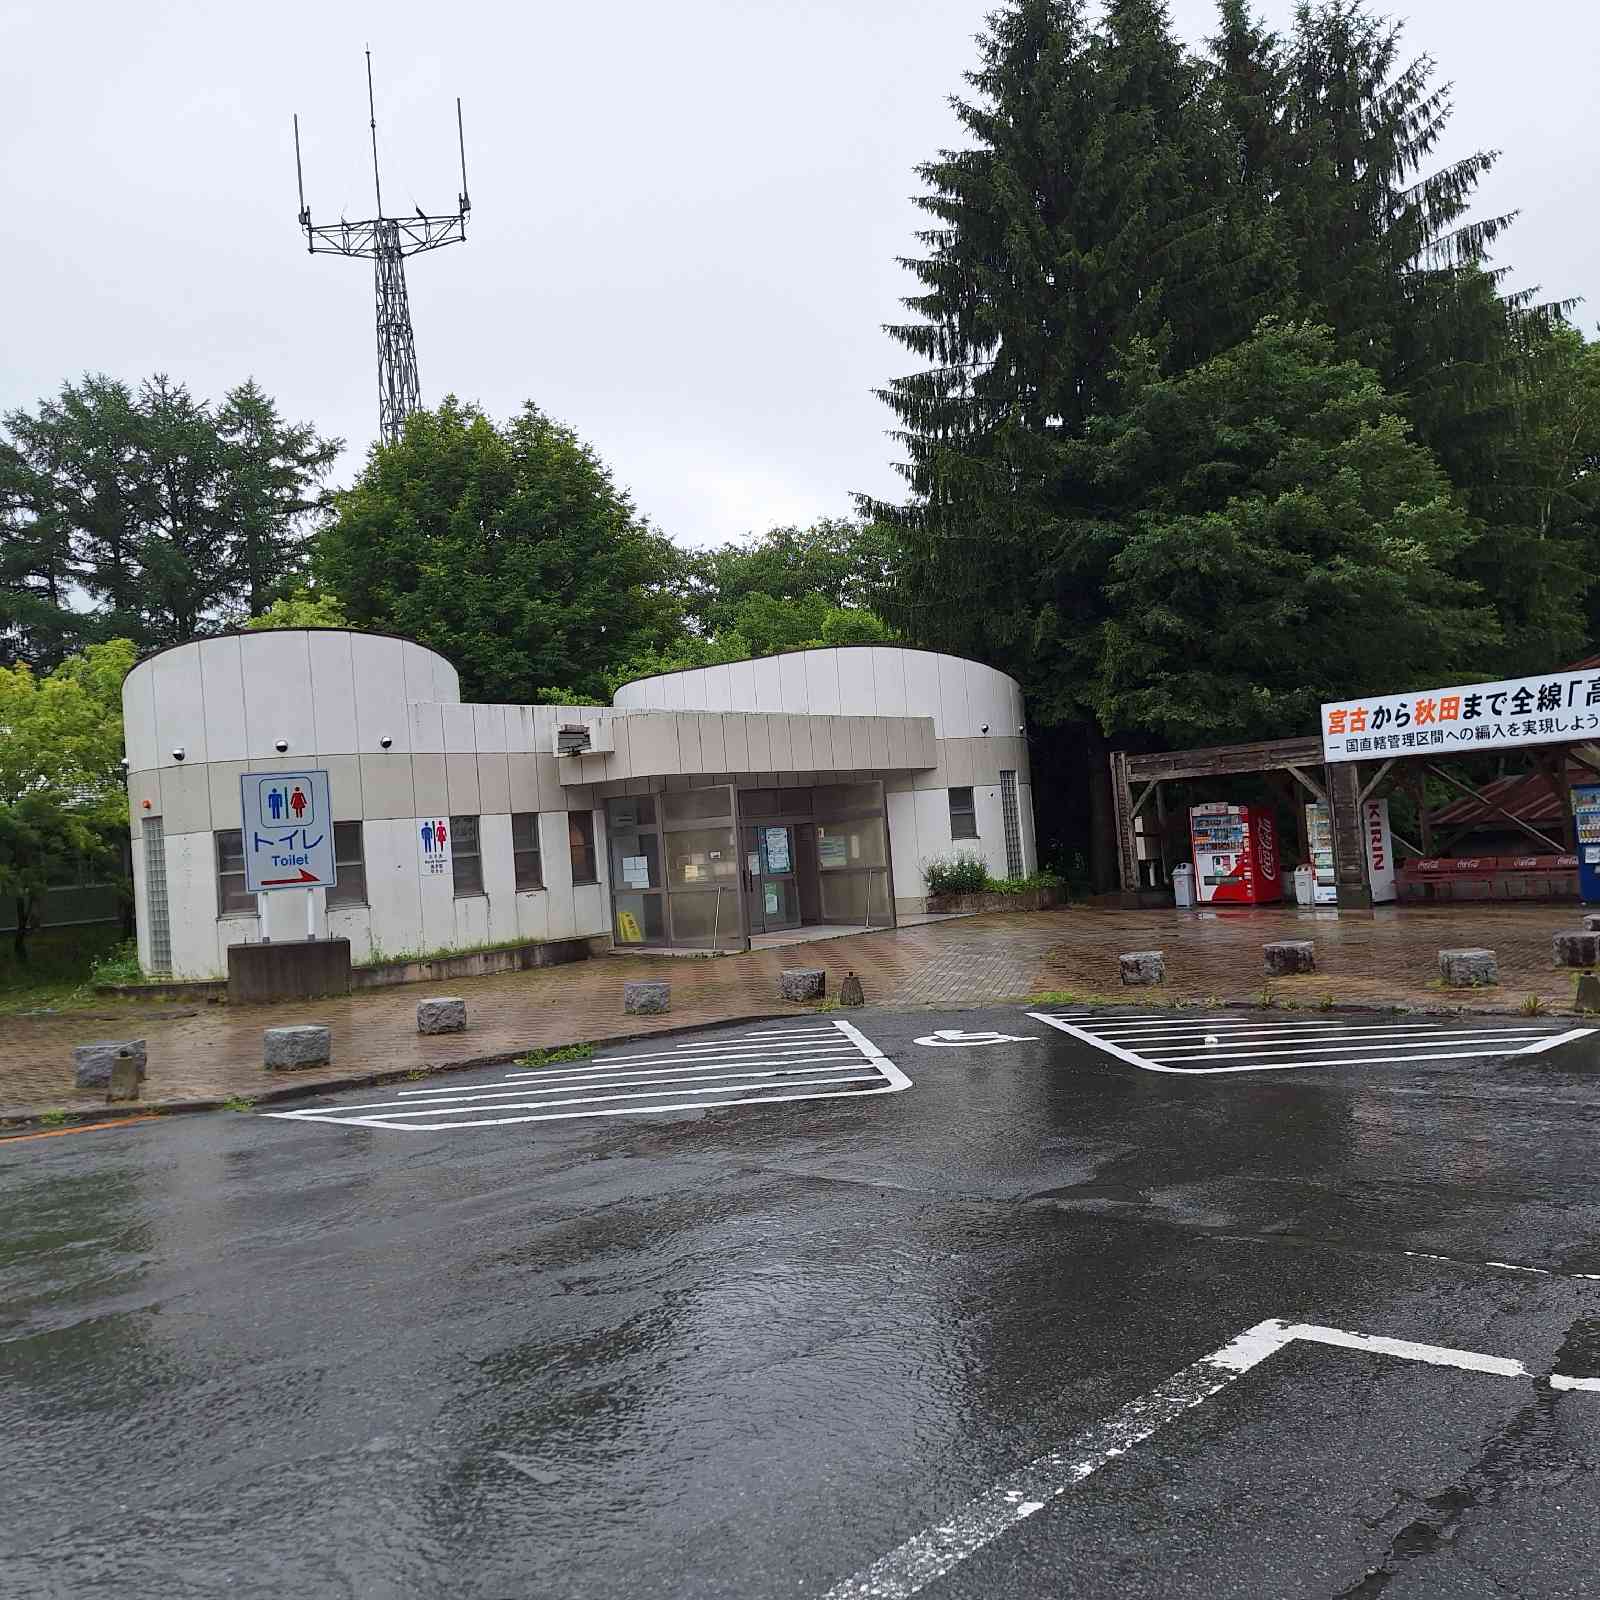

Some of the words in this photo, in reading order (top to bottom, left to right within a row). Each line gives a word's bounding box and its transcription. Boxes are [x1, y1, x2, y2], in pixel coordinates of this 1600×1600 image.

[254, 829, 324, 852] トイレ
[1368, 803, 1385, 871] KIRIN
[271, 854, 309, 867] Toilet
